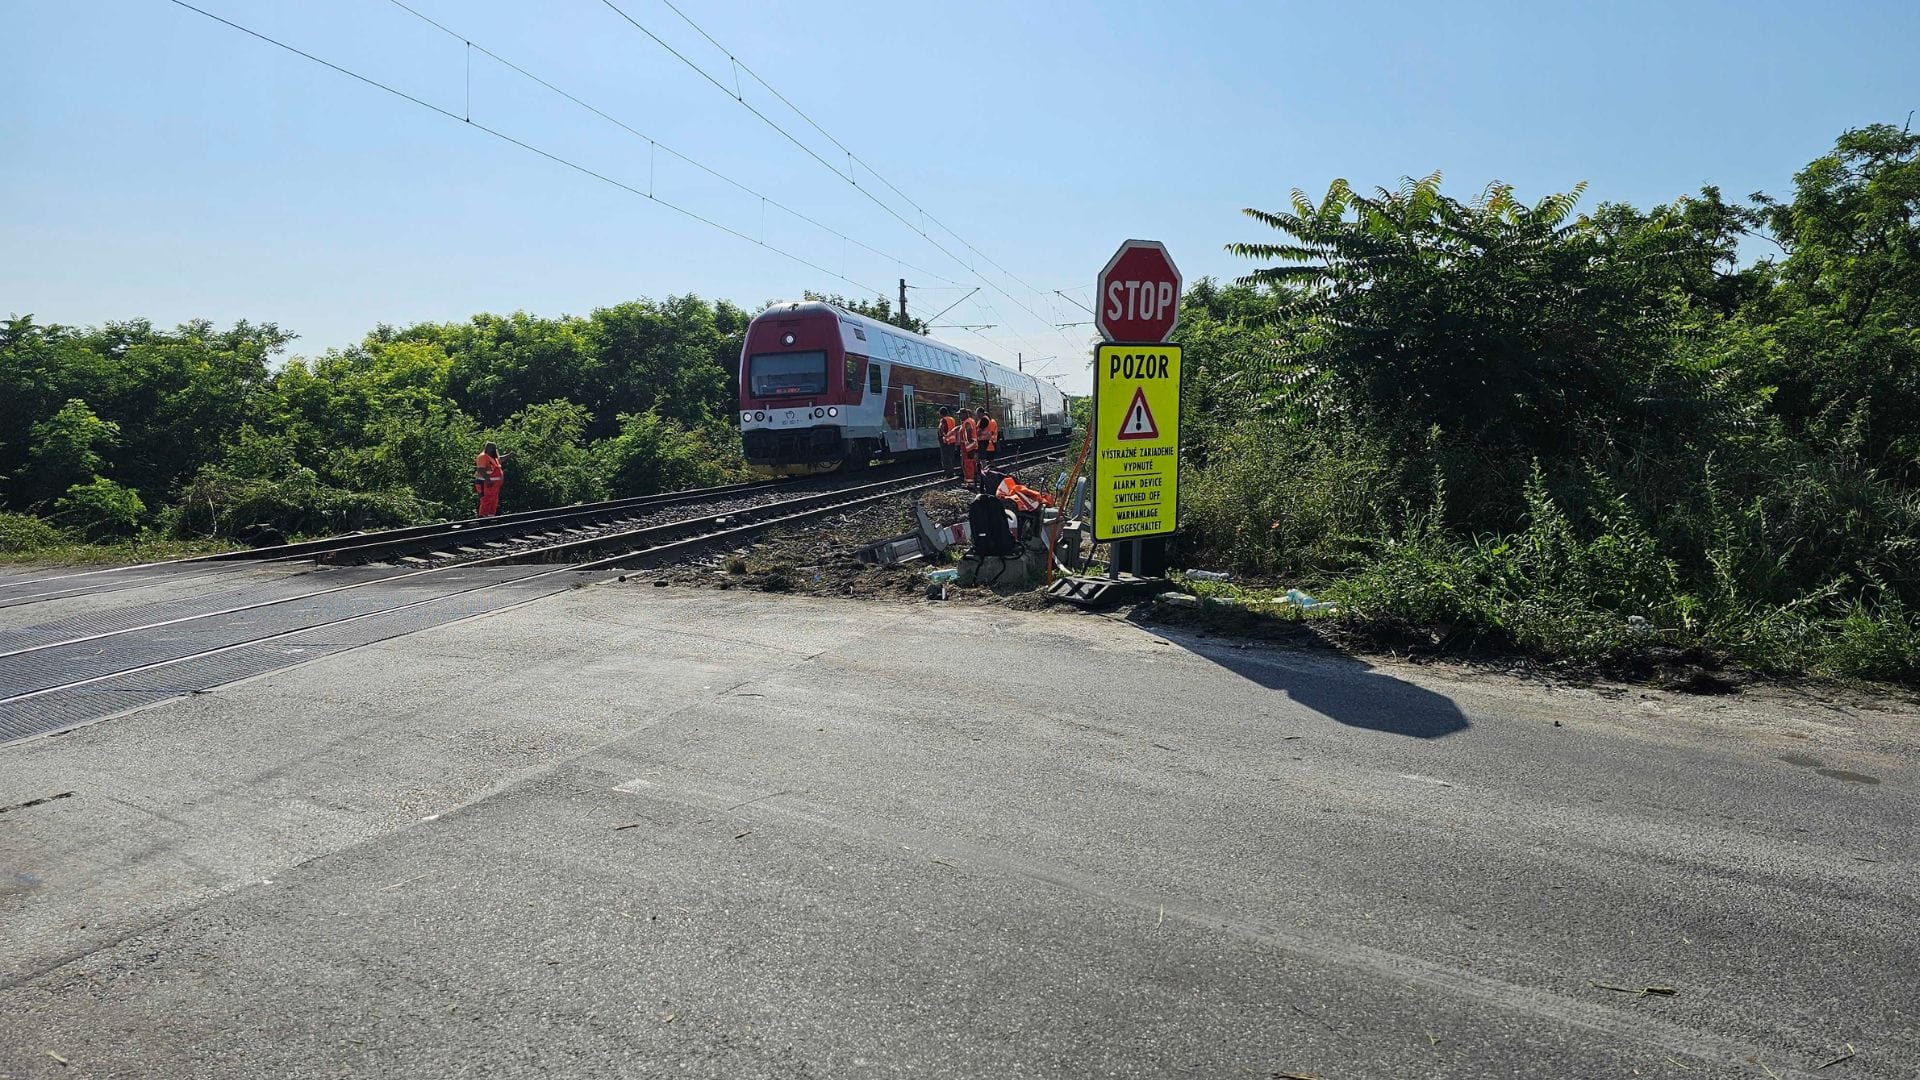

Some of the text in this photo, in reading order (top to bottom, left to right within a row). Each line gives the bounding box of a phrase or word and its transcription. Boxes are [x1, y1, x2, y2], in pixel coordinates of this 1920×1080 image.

[1107, 280, 1172, 320] STOP
[1110, 354, 1168, 379] POZOR
[1102, 446, 1174, 459] VÝSTRAŽNÉ ZARIADENIE
[1124, 460, 1153, 471] VYPNUTÉ
[1113, 478, 1162, 489] ALARM DEVICE
[1115, 491, 1160, 503] SWITCHED OFF
[1117, 509, 1158, 520] WARNANLAGE
[1112, 521, 1161, 534] AUSGESCHALTET
